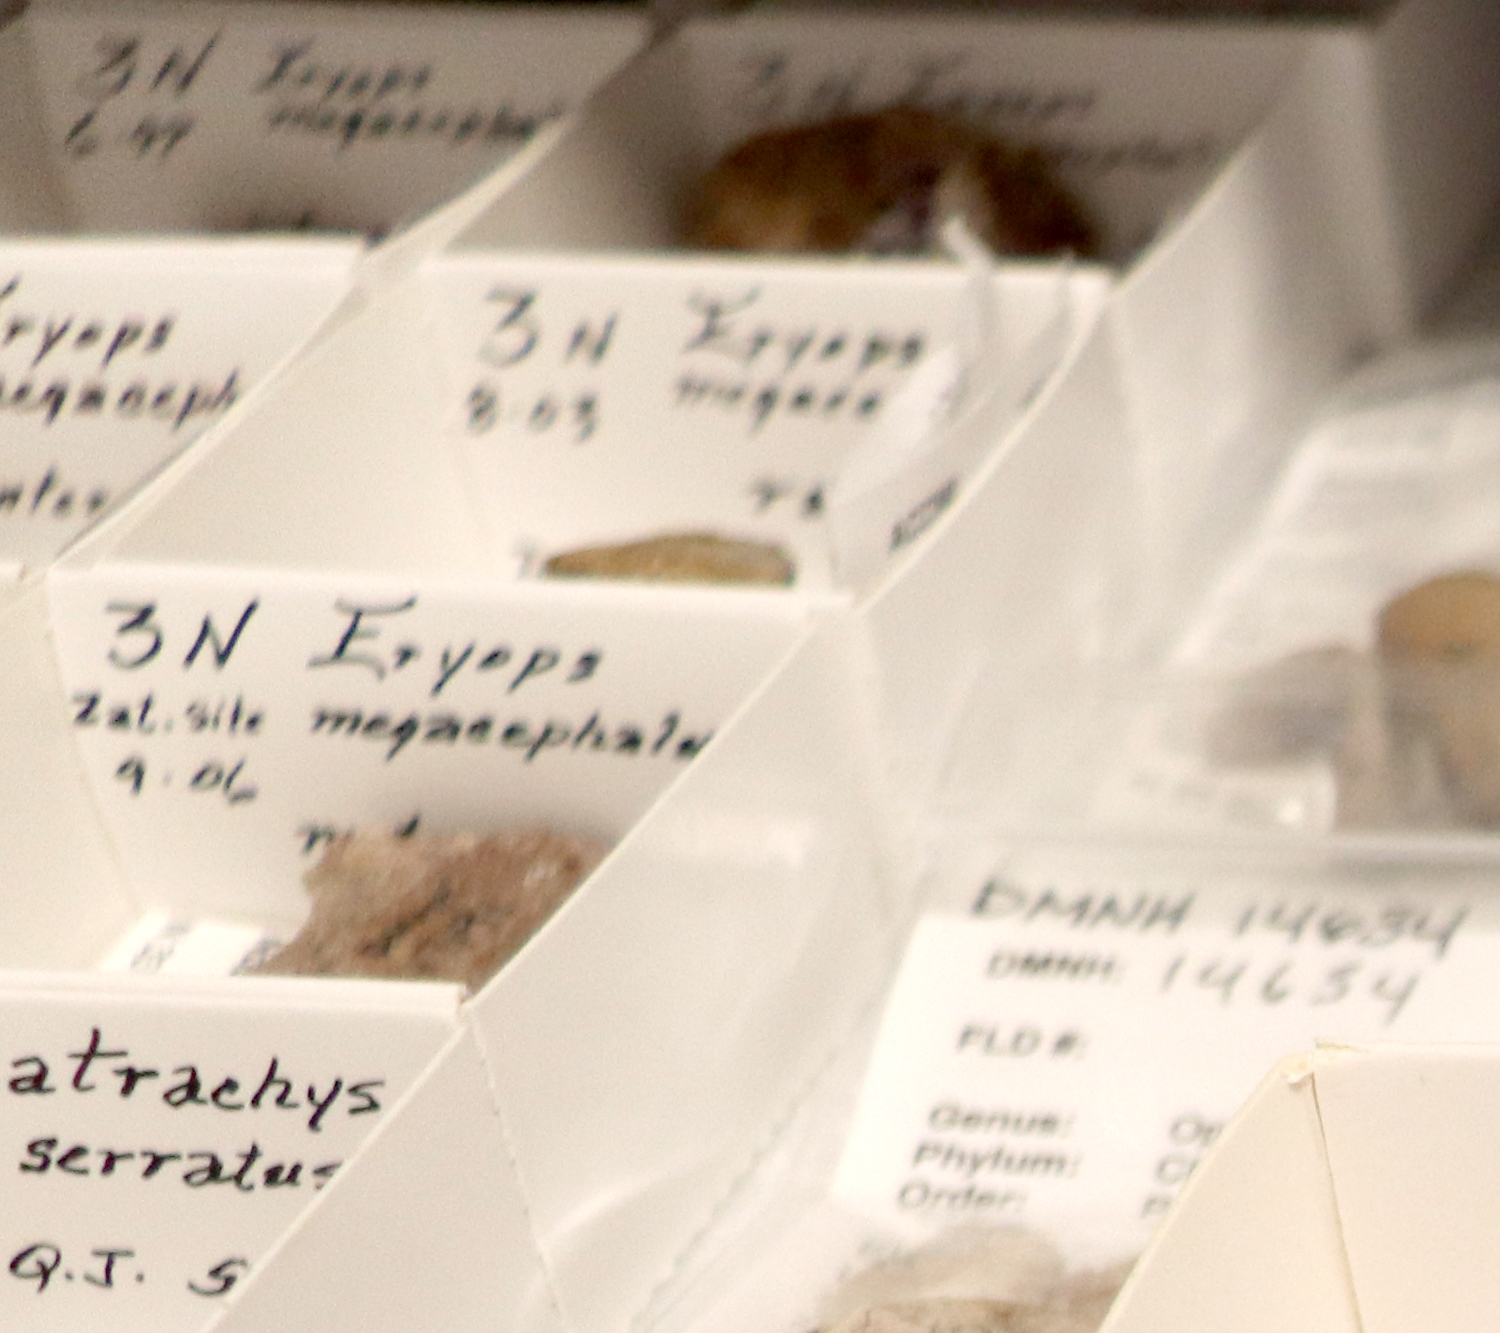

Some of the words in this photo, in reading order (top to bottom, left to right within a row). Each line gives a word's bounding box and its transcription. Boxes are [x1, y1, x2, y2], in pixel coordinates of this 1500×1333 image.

[0, 295, 178, 370] ryops
[477, 283, 541, 368] 3
[563, 309, 620, 367] N
[0, 366, 243, 430] egaceph
[103, 597, 164, 672] 3
[182, 595, 262, 671] N
[306, 594, 602, 698] Eryops
[8, 1025, 388, 1133] atrachys
[927, 1100, 1076, 1136] Genus:
[911, 1141, 1081, 1180] Phylum:
[896, 1181, 1028, 1215] Order:
